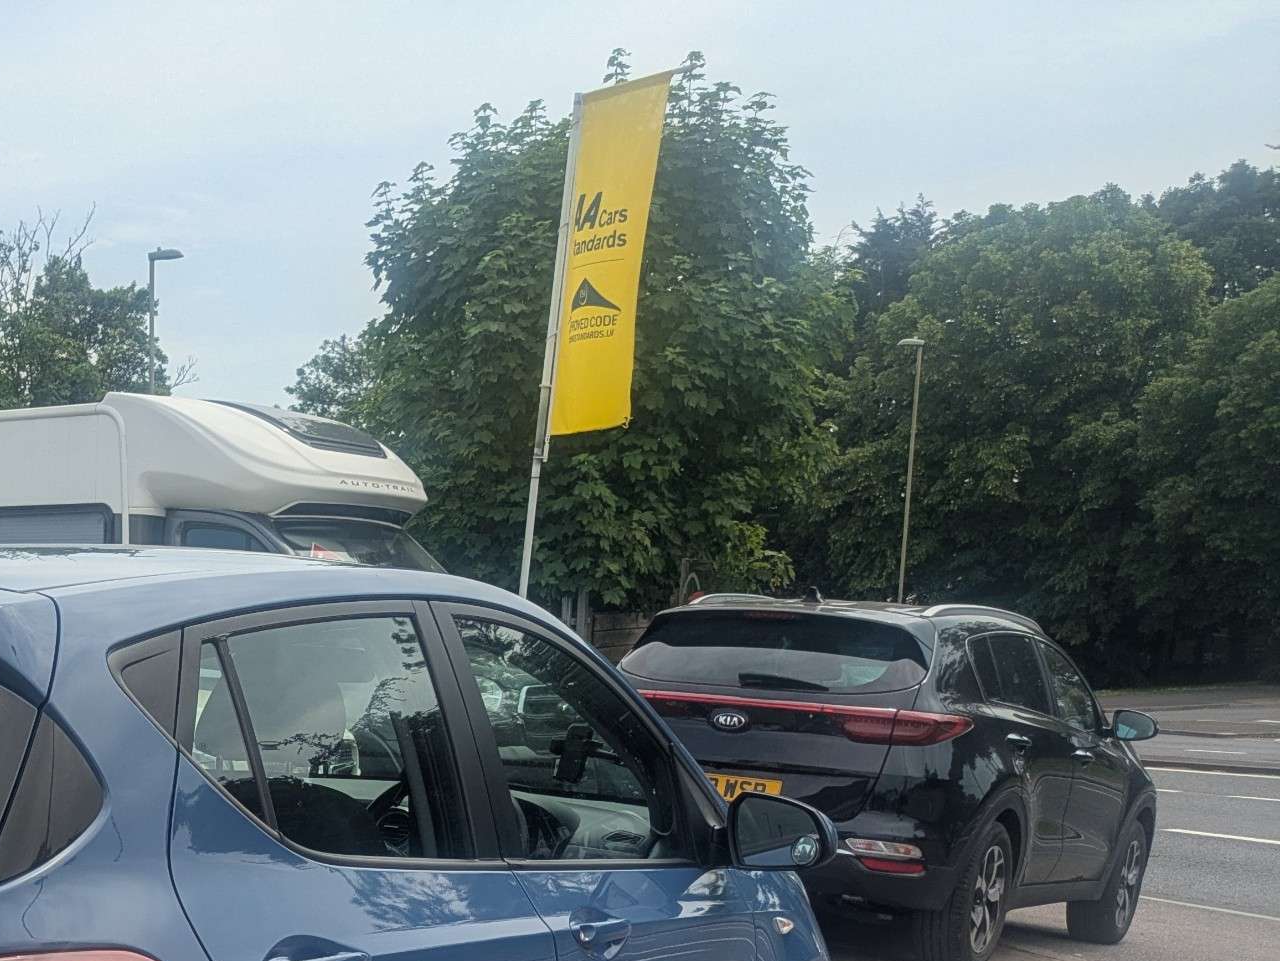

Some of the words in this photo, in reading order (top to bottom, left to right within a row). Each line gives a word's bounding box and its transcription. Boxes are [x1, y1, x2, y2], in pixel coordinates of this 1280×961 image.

[599, 208, 628, 228] Cars
[573, 230, 627, 256] tandards
[590, 314, 619, 328] CODE
[718, 715, 739, 725] KIA
